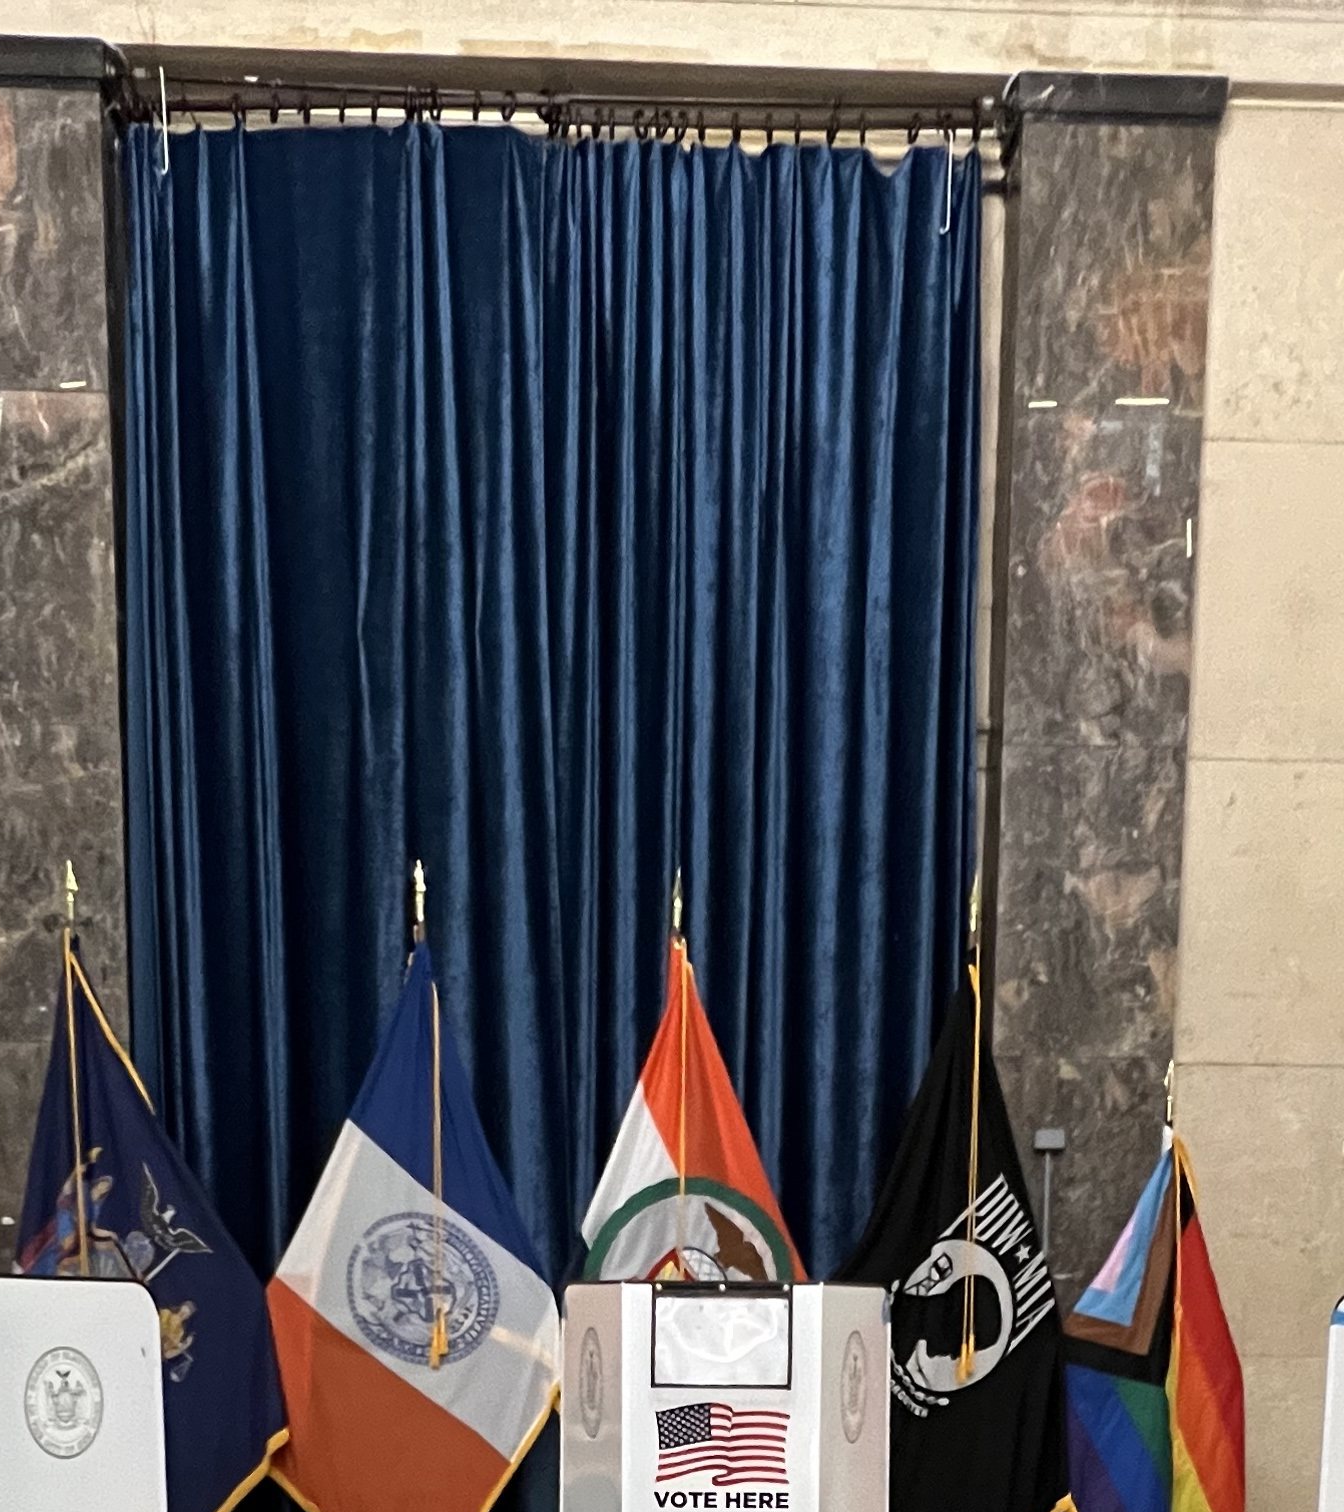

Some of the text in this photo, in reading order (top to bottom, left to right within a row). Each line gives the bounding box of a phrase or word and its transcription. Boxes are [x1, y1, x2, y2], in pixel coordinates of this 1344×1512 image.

[939, 1172, 1055, 1356] POW MIA
[654, 1491, 790, 1509] VOTE HERE
